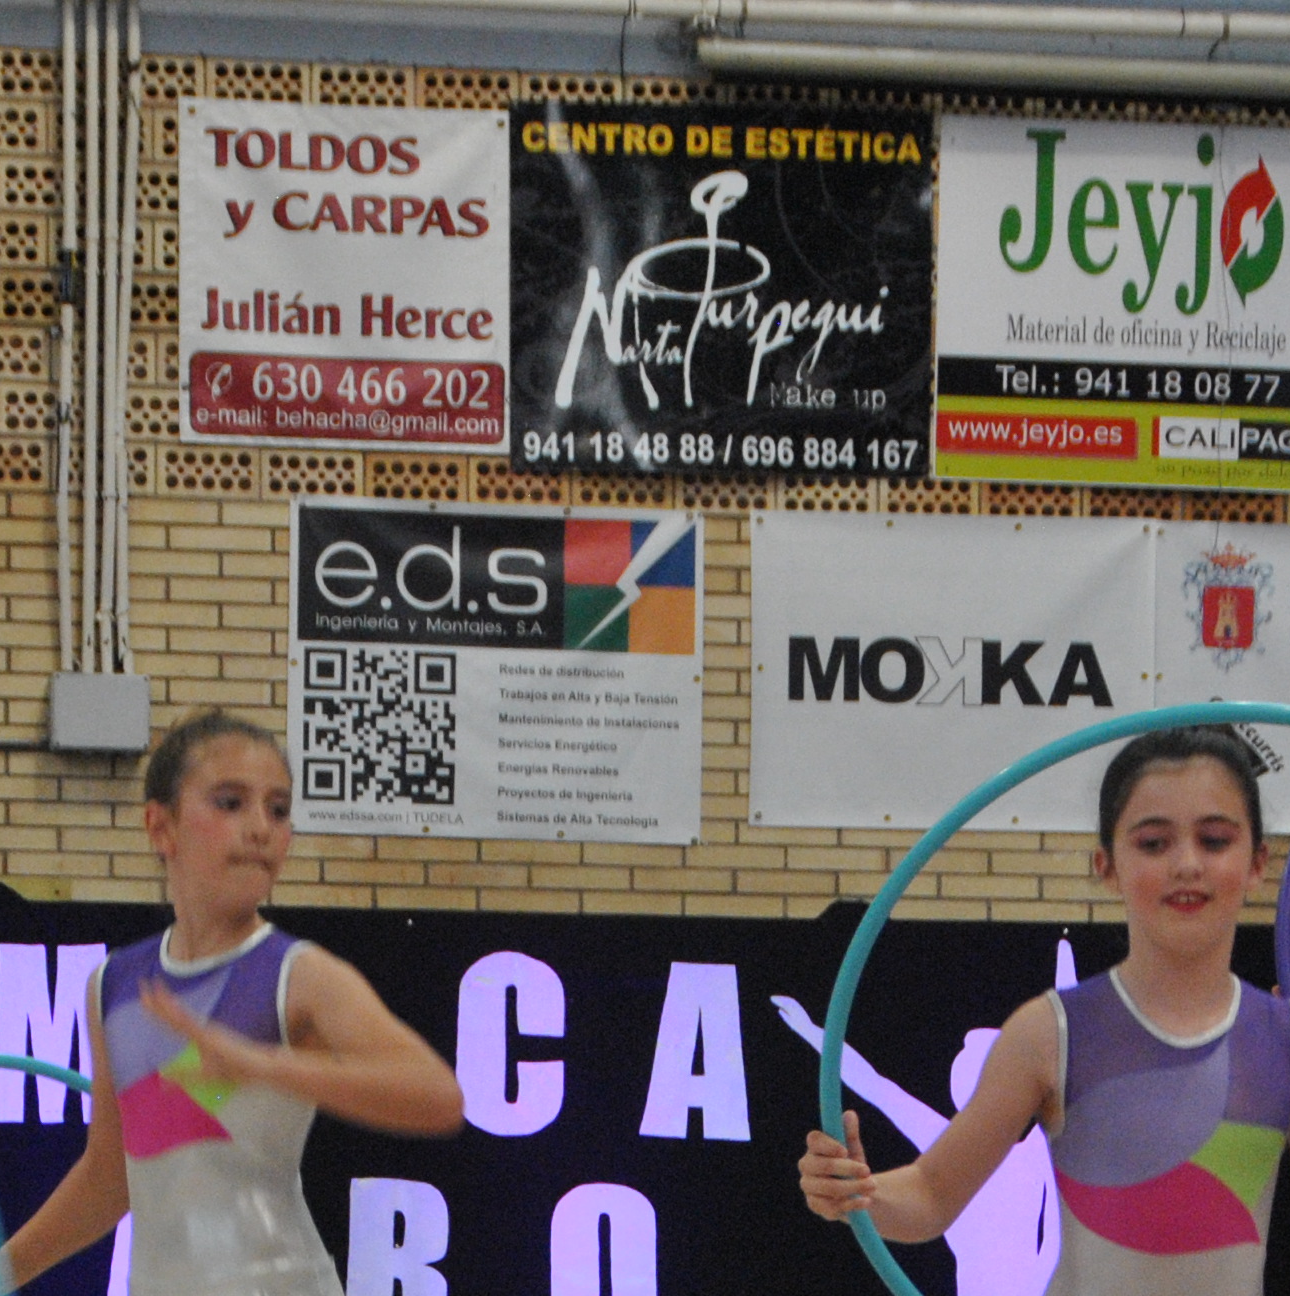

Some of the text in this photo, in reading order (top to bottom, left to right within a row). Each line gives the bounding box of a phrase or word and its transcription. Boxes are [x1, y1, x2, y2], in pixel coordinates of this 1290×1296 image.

[204, 127, 420, 176] TOLDOS
[522, 121, 922, 164] CENTRO DE ESTÉTICA
[223, 191, 490, 238] y CARPAS
[201, 286, 494, 341] Julián Herce
[1007, 314, 1286, 358] Material de oficina y Reciclaje
[252, 361, 491, 410] 630 466 202
[996, 364, 1280, 402] Tel.: 941 18 08 77
[196, 407, 500, 437] e-mail: behacha@gmail.com
[948, 418, 1123, 449] www.jeyjo.es
[523, 431, 576, 462] 941
[589, 432, 623, 462] 18
[634, 432, 669, 463] 48
[679, 433, 715, 463] 88
[741, 437, 794, 466] 696
[803, 438, 856, 468] 884
[867, 440, 918, 470] 167
[409, 619, 418, 635] y
[499, 664, 625, 680] Redes de distribución
[499, 688, 548, 704] Trabajos
[551, 691, 565, 701] en
[568, 690, 591, 702] Alta
[604, 691, 630, 707] Baja
[634, 691, 678, 706] Tensión
[498, 712, 680, 731] Mantenimiento de Instalaciones
[498, 737, 551, 750] Servicios
[552, 764, 619, 777] Renovables
[497, 786, 555, 801] Proyectos
[559, 789, 573, 800] de
[414, 811, 464, 825] TUDELA
[497, 811, 549, 825] Sistemas
[553, 813, 567, 825] de
[570, 814, 592, 826] Alta
